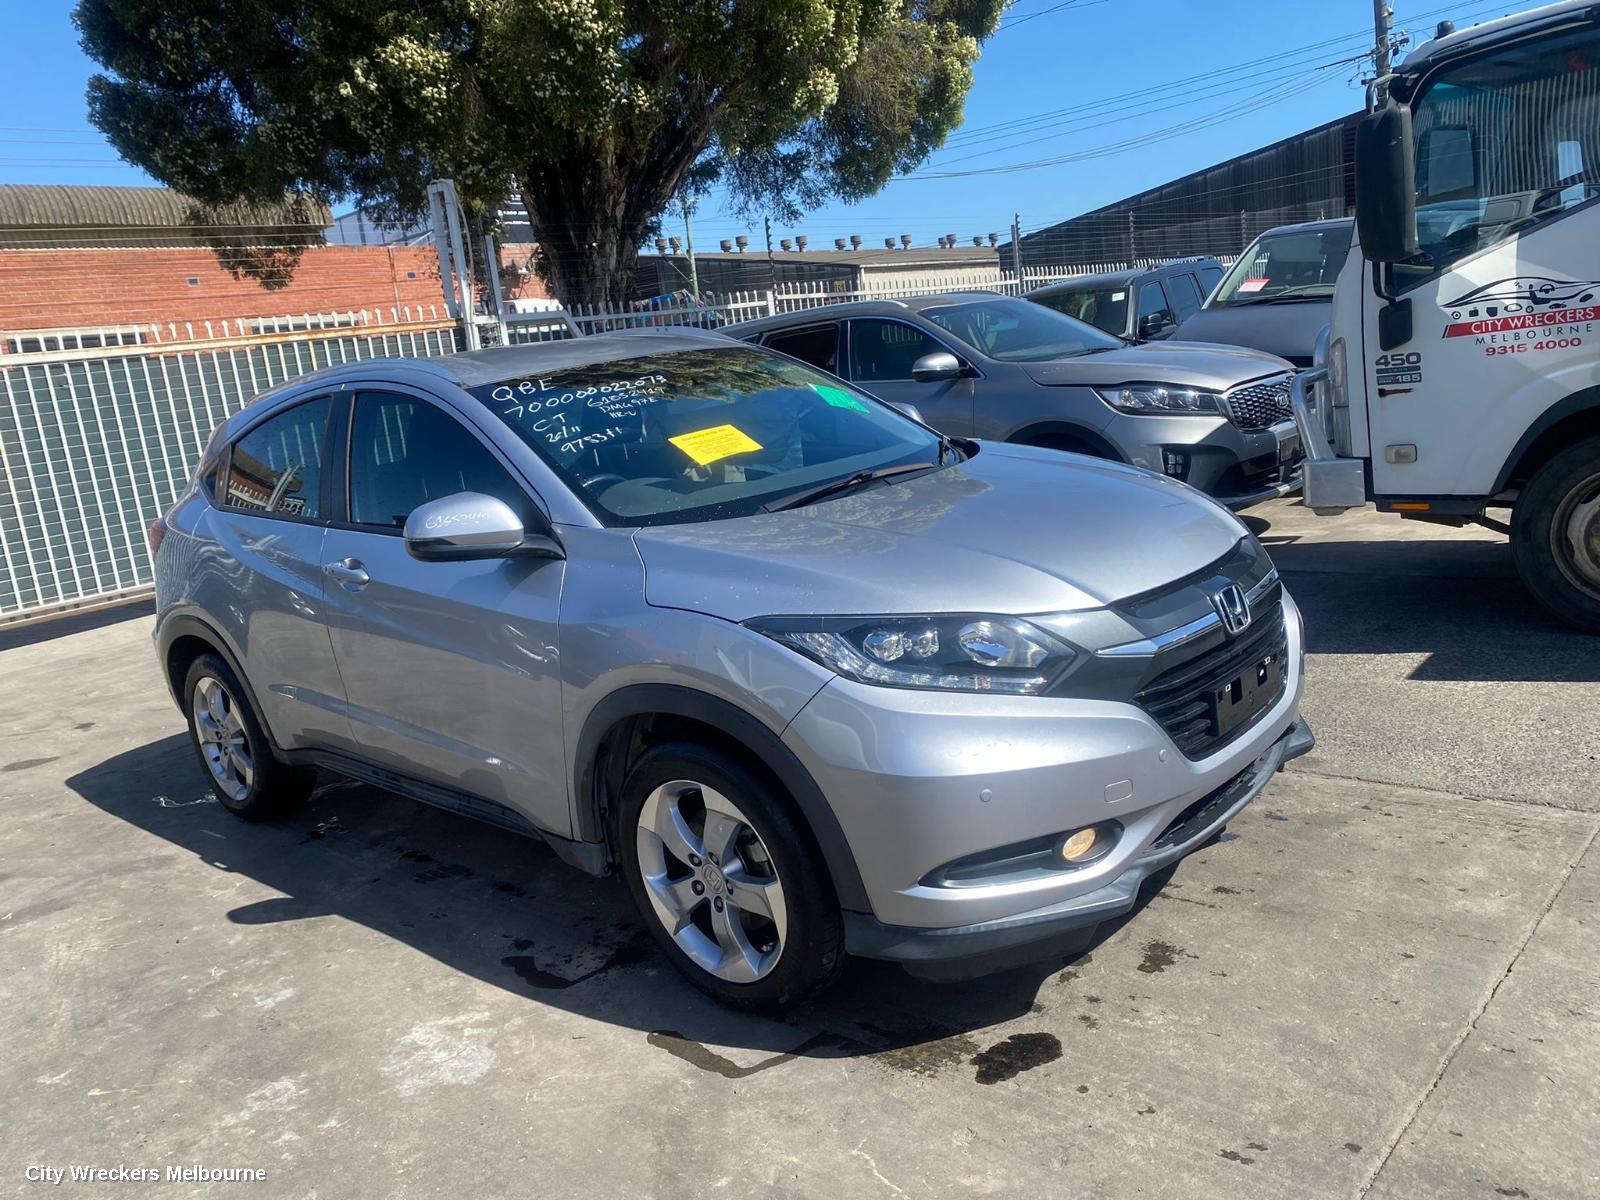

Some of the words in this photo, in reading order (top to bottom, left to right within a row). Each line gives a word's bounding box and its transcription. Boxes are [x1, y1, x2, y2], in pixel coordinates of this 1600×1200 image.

[1471, 319, 1504, 334] CITY
[1507, 308, 1595, 328] WRECKERS
[1475, 324, 1593, 345] MELBOURNE
[1486, 343, 1528, 356] 9315
[1534, 337, 1582, 351] 4000
[1375, 352, 1421, 367] 450
[1396, 373, 1421, 383] 185
[492, 377, 556, 404] QBE
